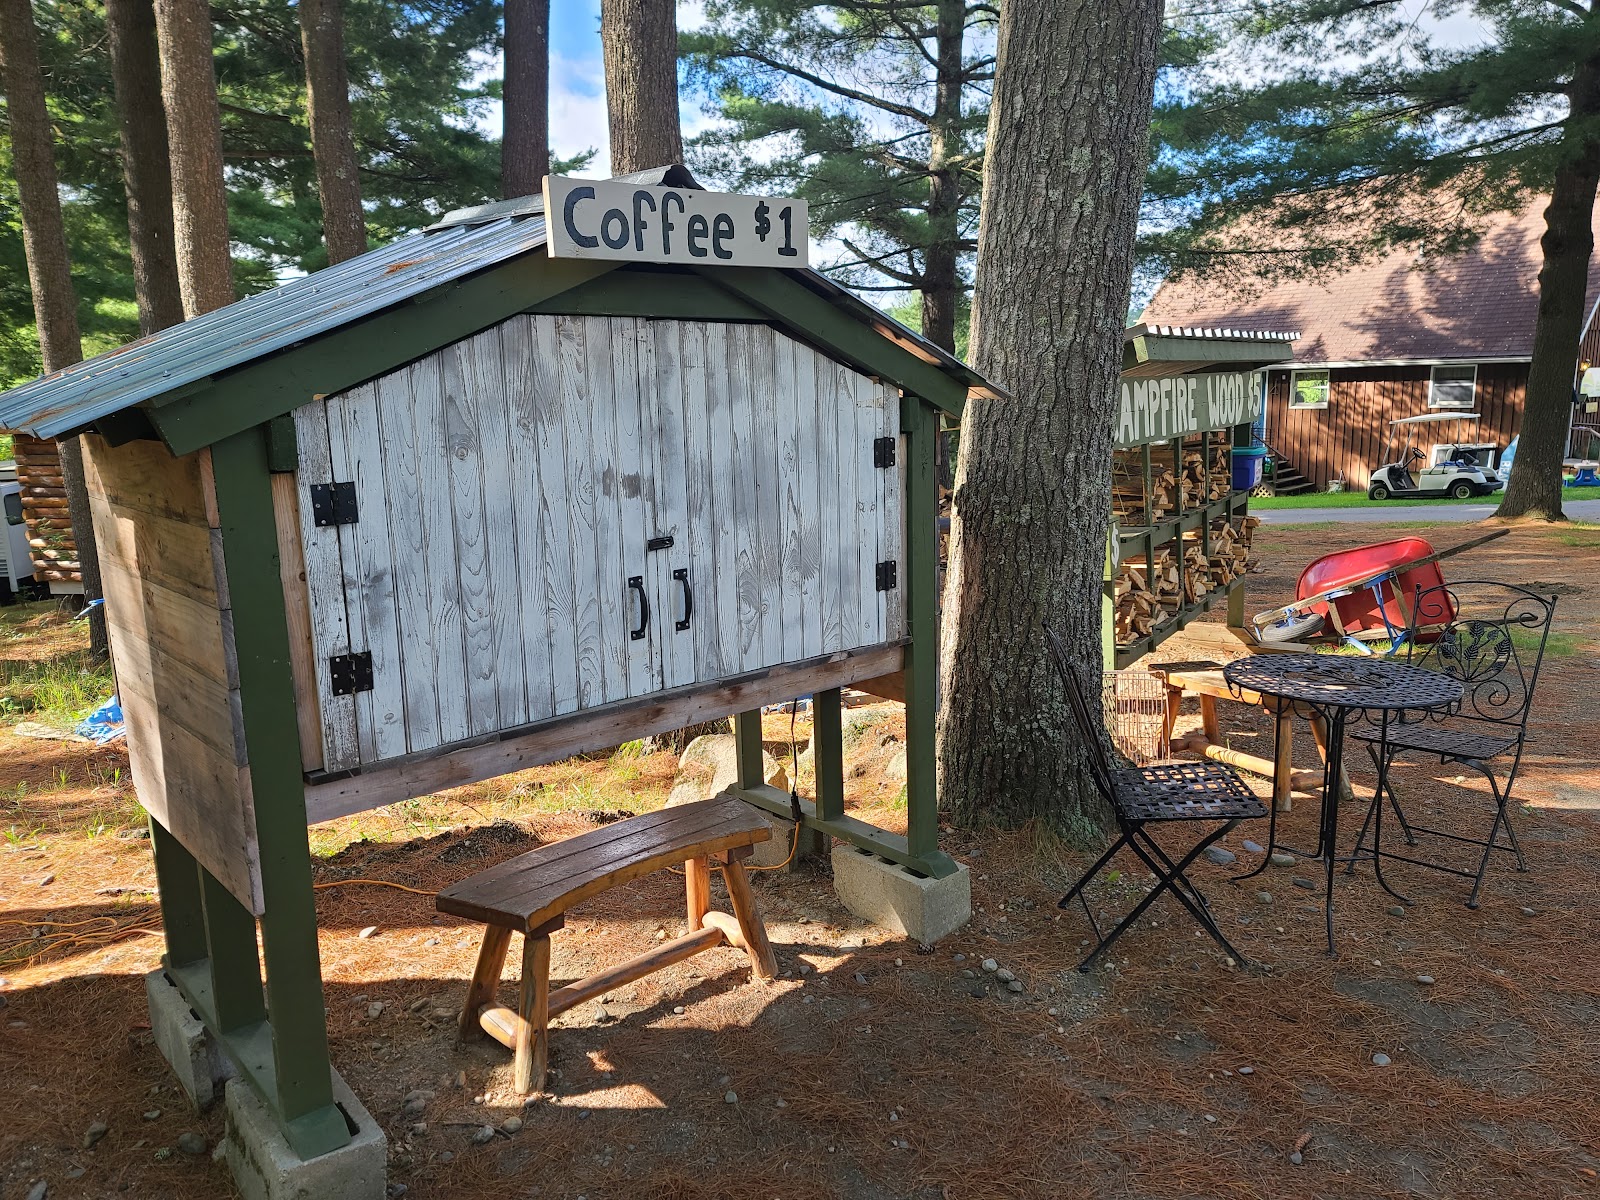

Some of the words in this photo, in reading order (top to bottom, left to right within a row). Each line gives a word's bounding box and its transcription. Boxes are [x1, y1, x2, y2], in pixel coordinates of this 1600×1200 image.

[563, 186, 735, 259] Coffee
[754, 200, 798, 257] $1
[1114, 377, 1197, 444] AMPFIRE
[1206, 373, 1244, 428] WOOD
[1248, 372, 1261, 418] $5
